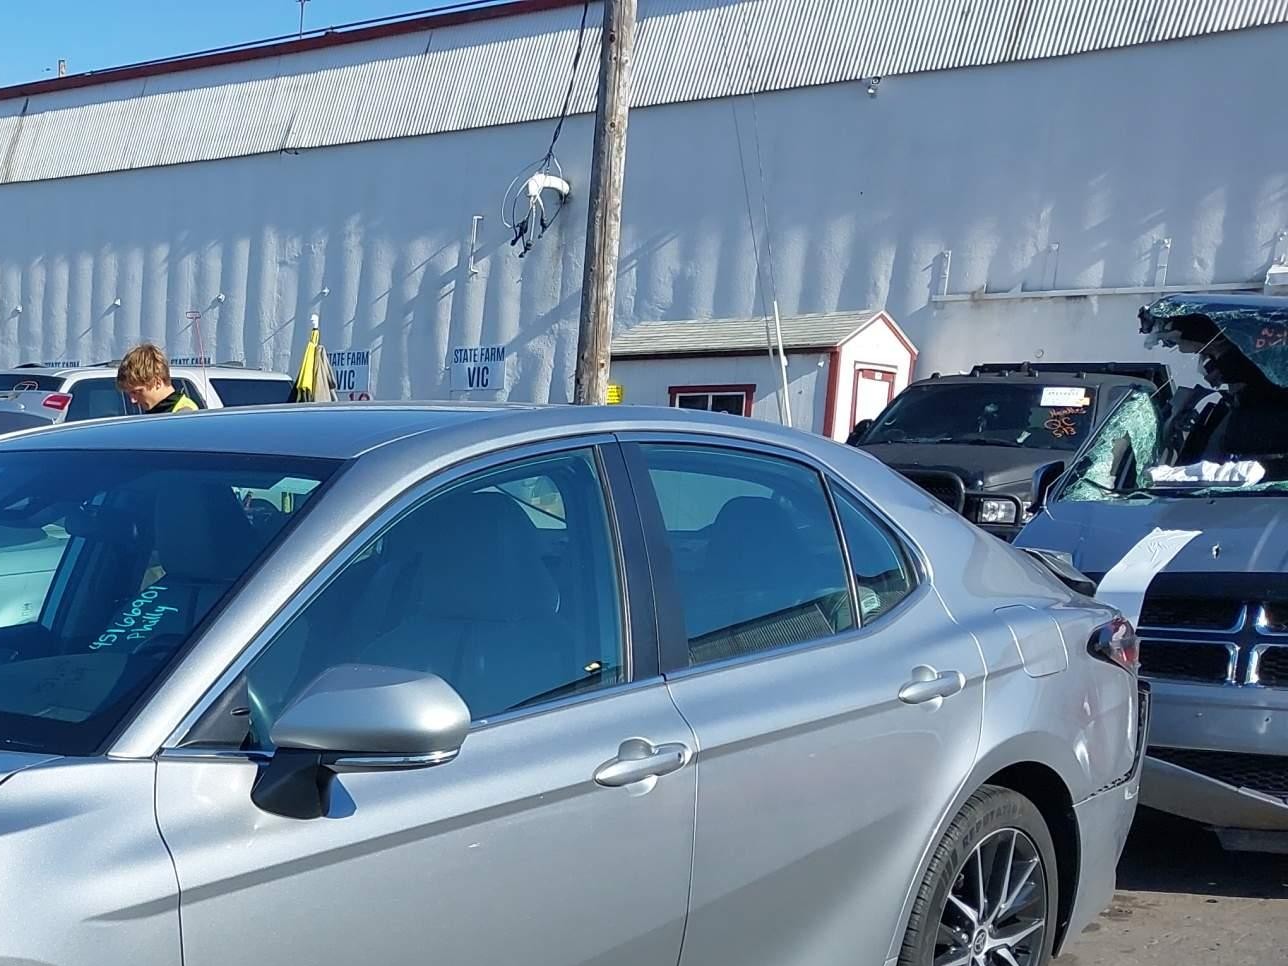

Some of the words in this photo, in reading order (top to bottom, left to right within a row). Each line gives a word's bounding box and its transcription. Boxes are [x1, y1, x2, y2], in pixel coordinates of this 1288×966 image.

[326, 352, 346, 366] TATE
[347, 351, 369, 366] FARM
[453, 348, 479, 363] STATE
[480, 347, 505, 362] FARM
[335, 369, 356, 390] VIC
[467, 366, 490, 388] VIC
[88, 586, 168, 649] 45166901
[126, 605, 179, 640] Philly
